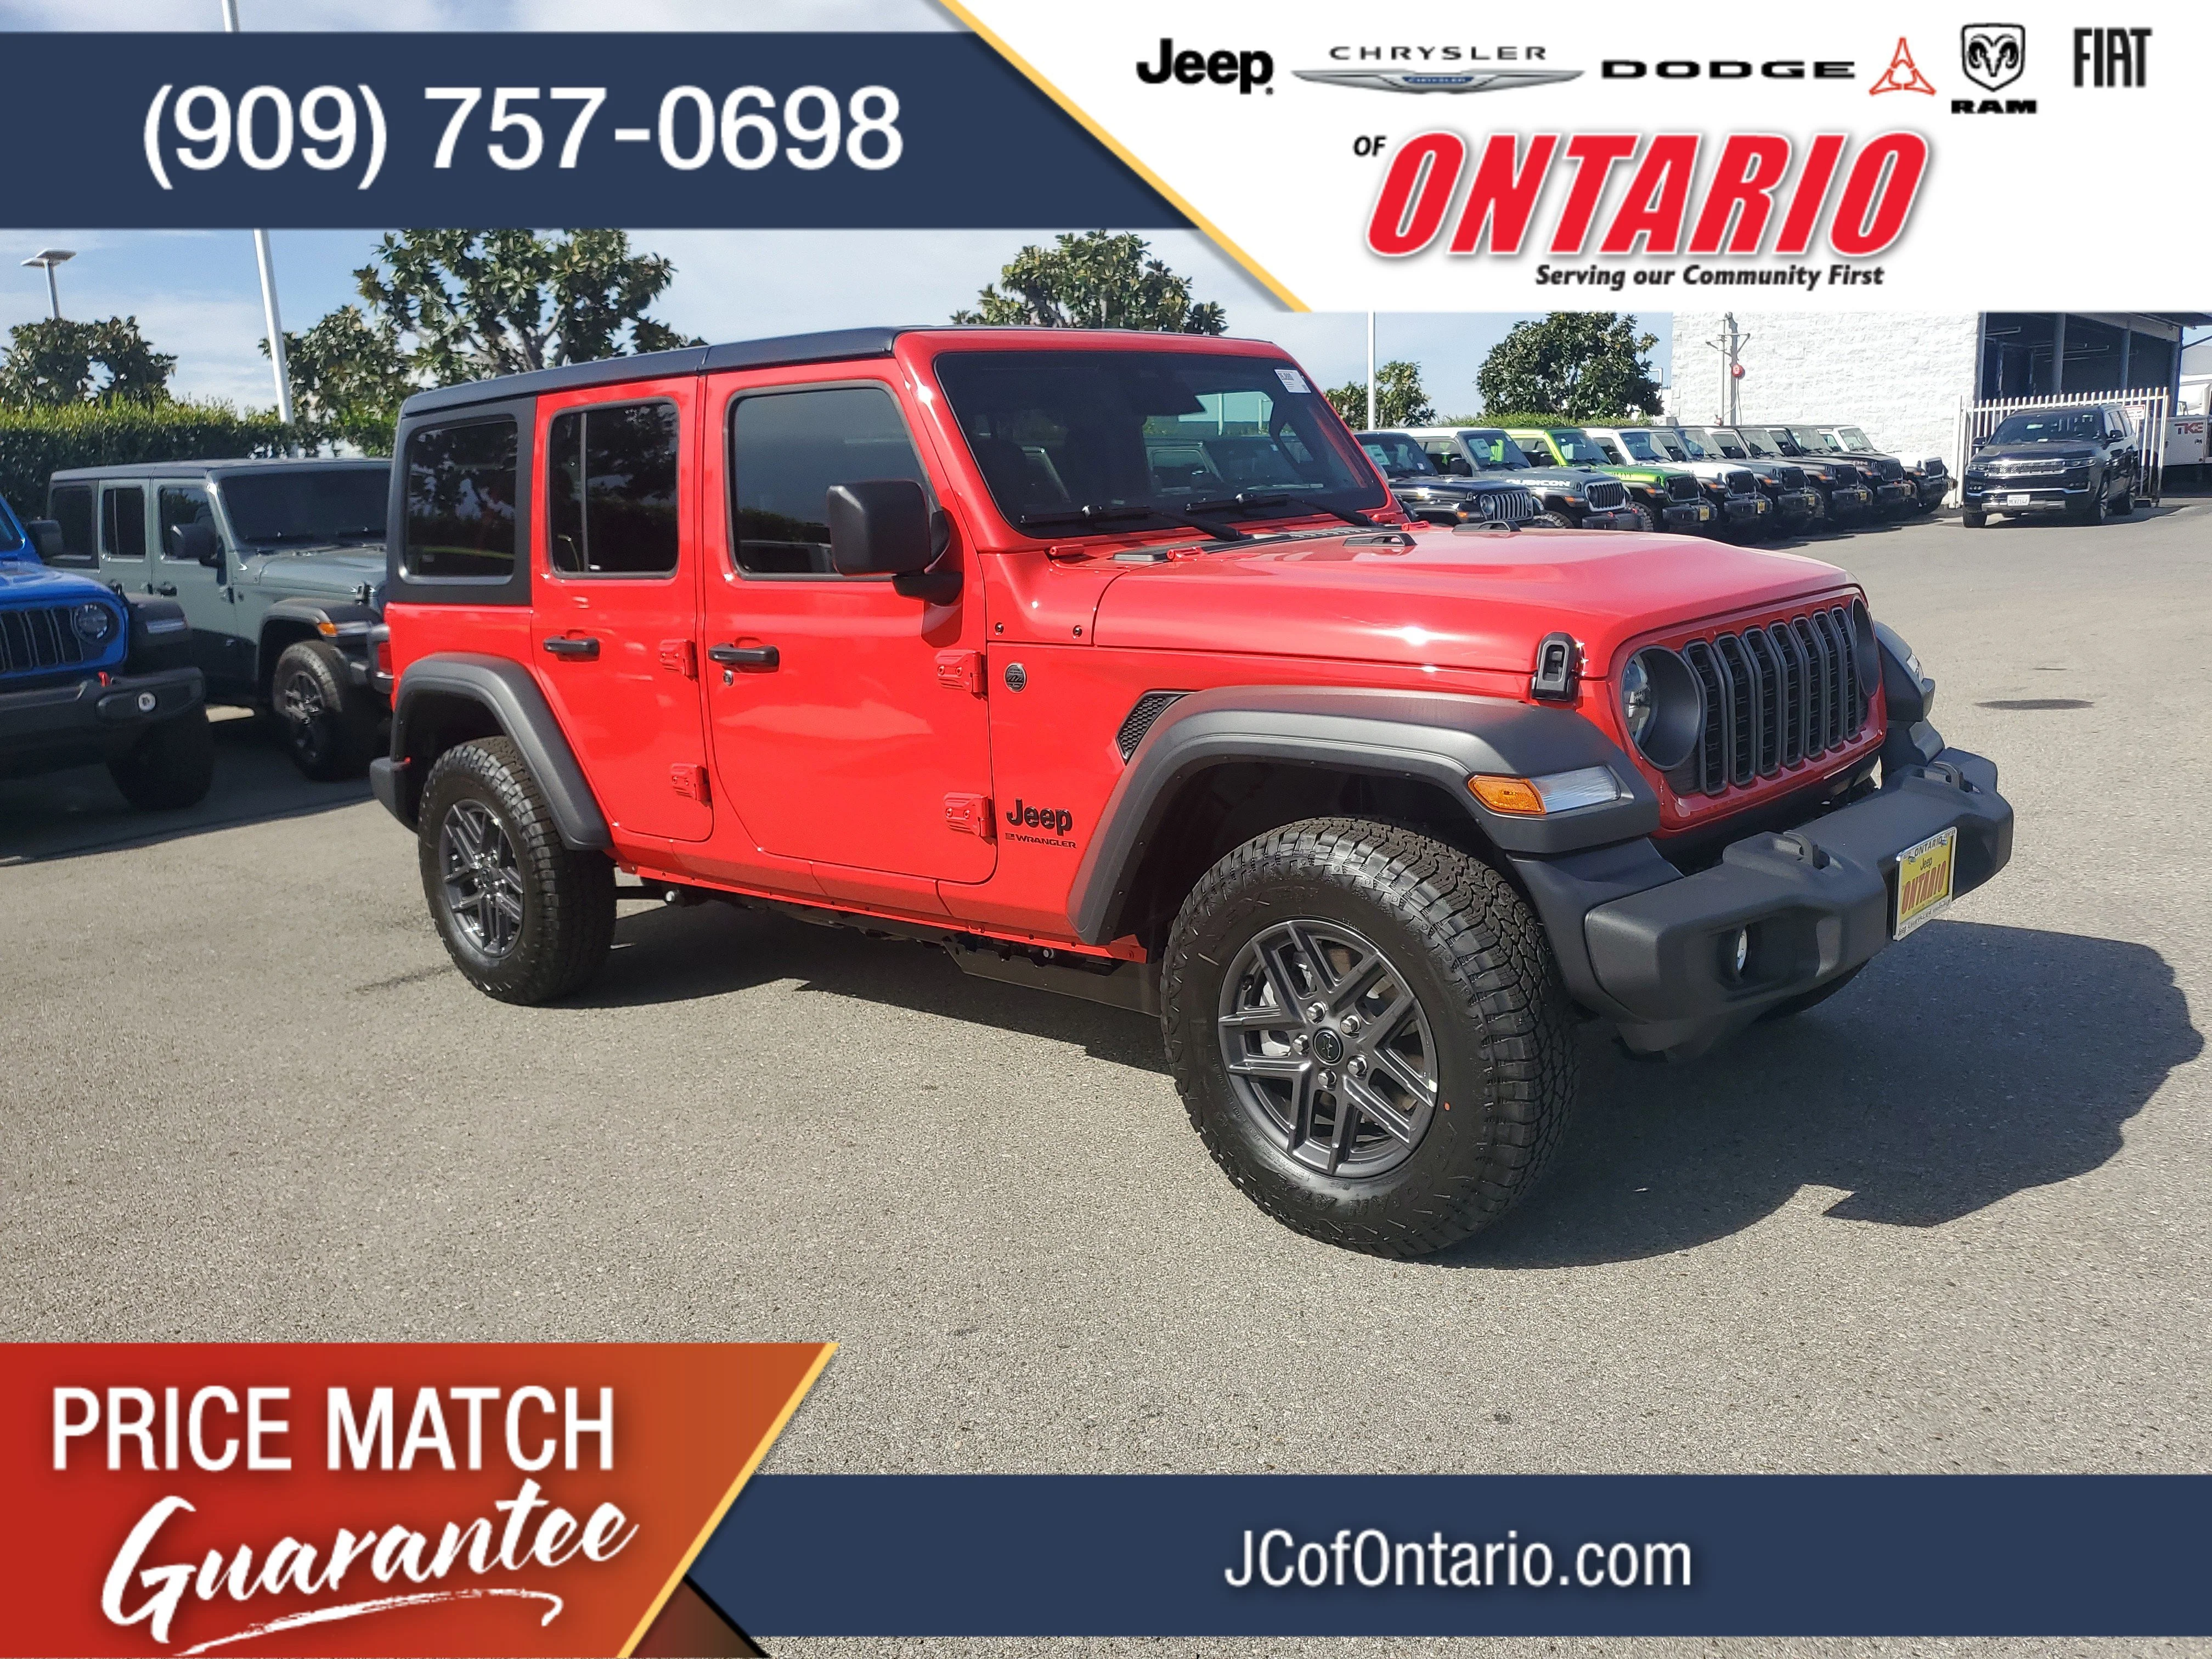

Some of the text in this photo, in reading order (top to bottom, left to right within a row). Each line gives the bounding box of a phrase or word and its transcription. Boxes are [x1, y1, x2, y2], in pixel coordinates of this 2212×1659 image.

[2174, 422, 2204, 435] TKE
[1006, 798, 1073, 837] Jeep
[1015, 834, 1077, 849] WRANGLER
[1914, 835, 1943, 857] ONTARIO
[1920, 856, 1933, 871] Jeep
[1901, 860, 1947, 915] ONTARIO
